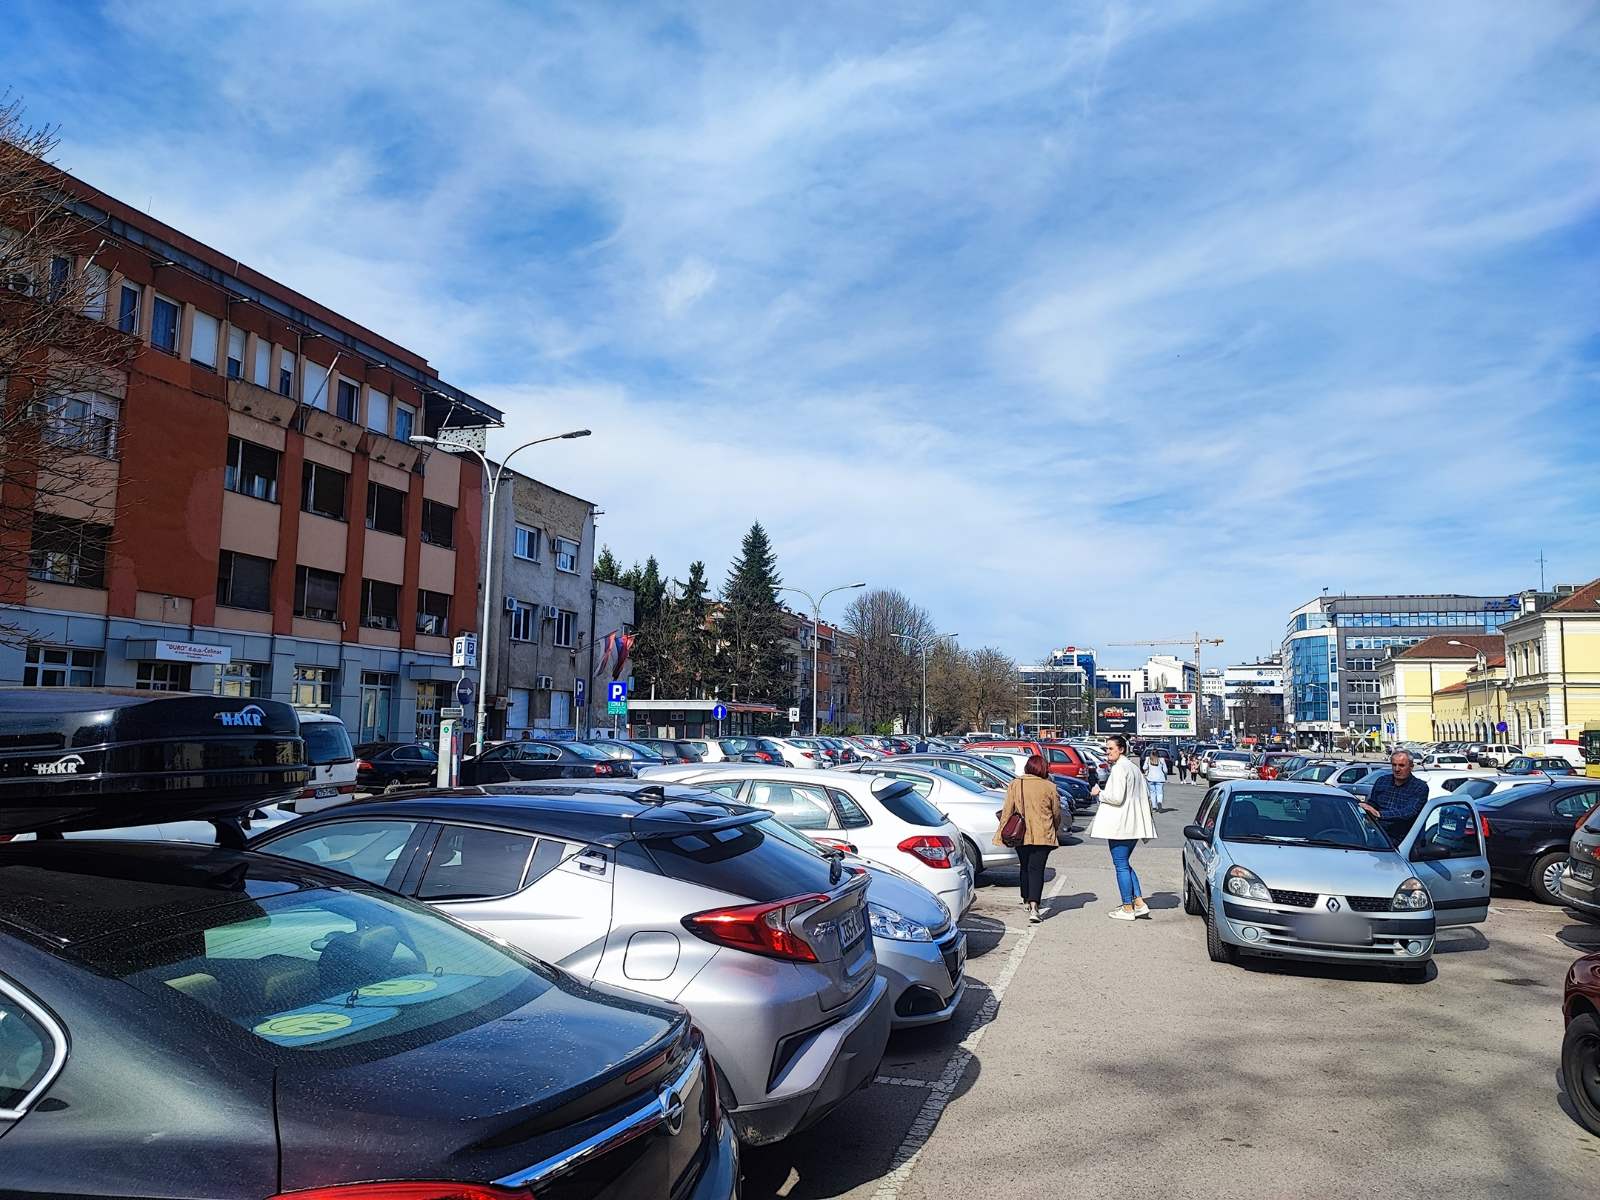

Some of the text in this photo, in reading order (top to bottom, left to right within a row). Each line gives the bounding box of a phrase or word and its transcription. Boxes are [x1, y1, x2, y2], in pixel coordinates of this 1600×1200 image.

[577, 680, 583, 695] P
[612, 684, 622, 699] P
[37, 761, 79, 775] HAKR
